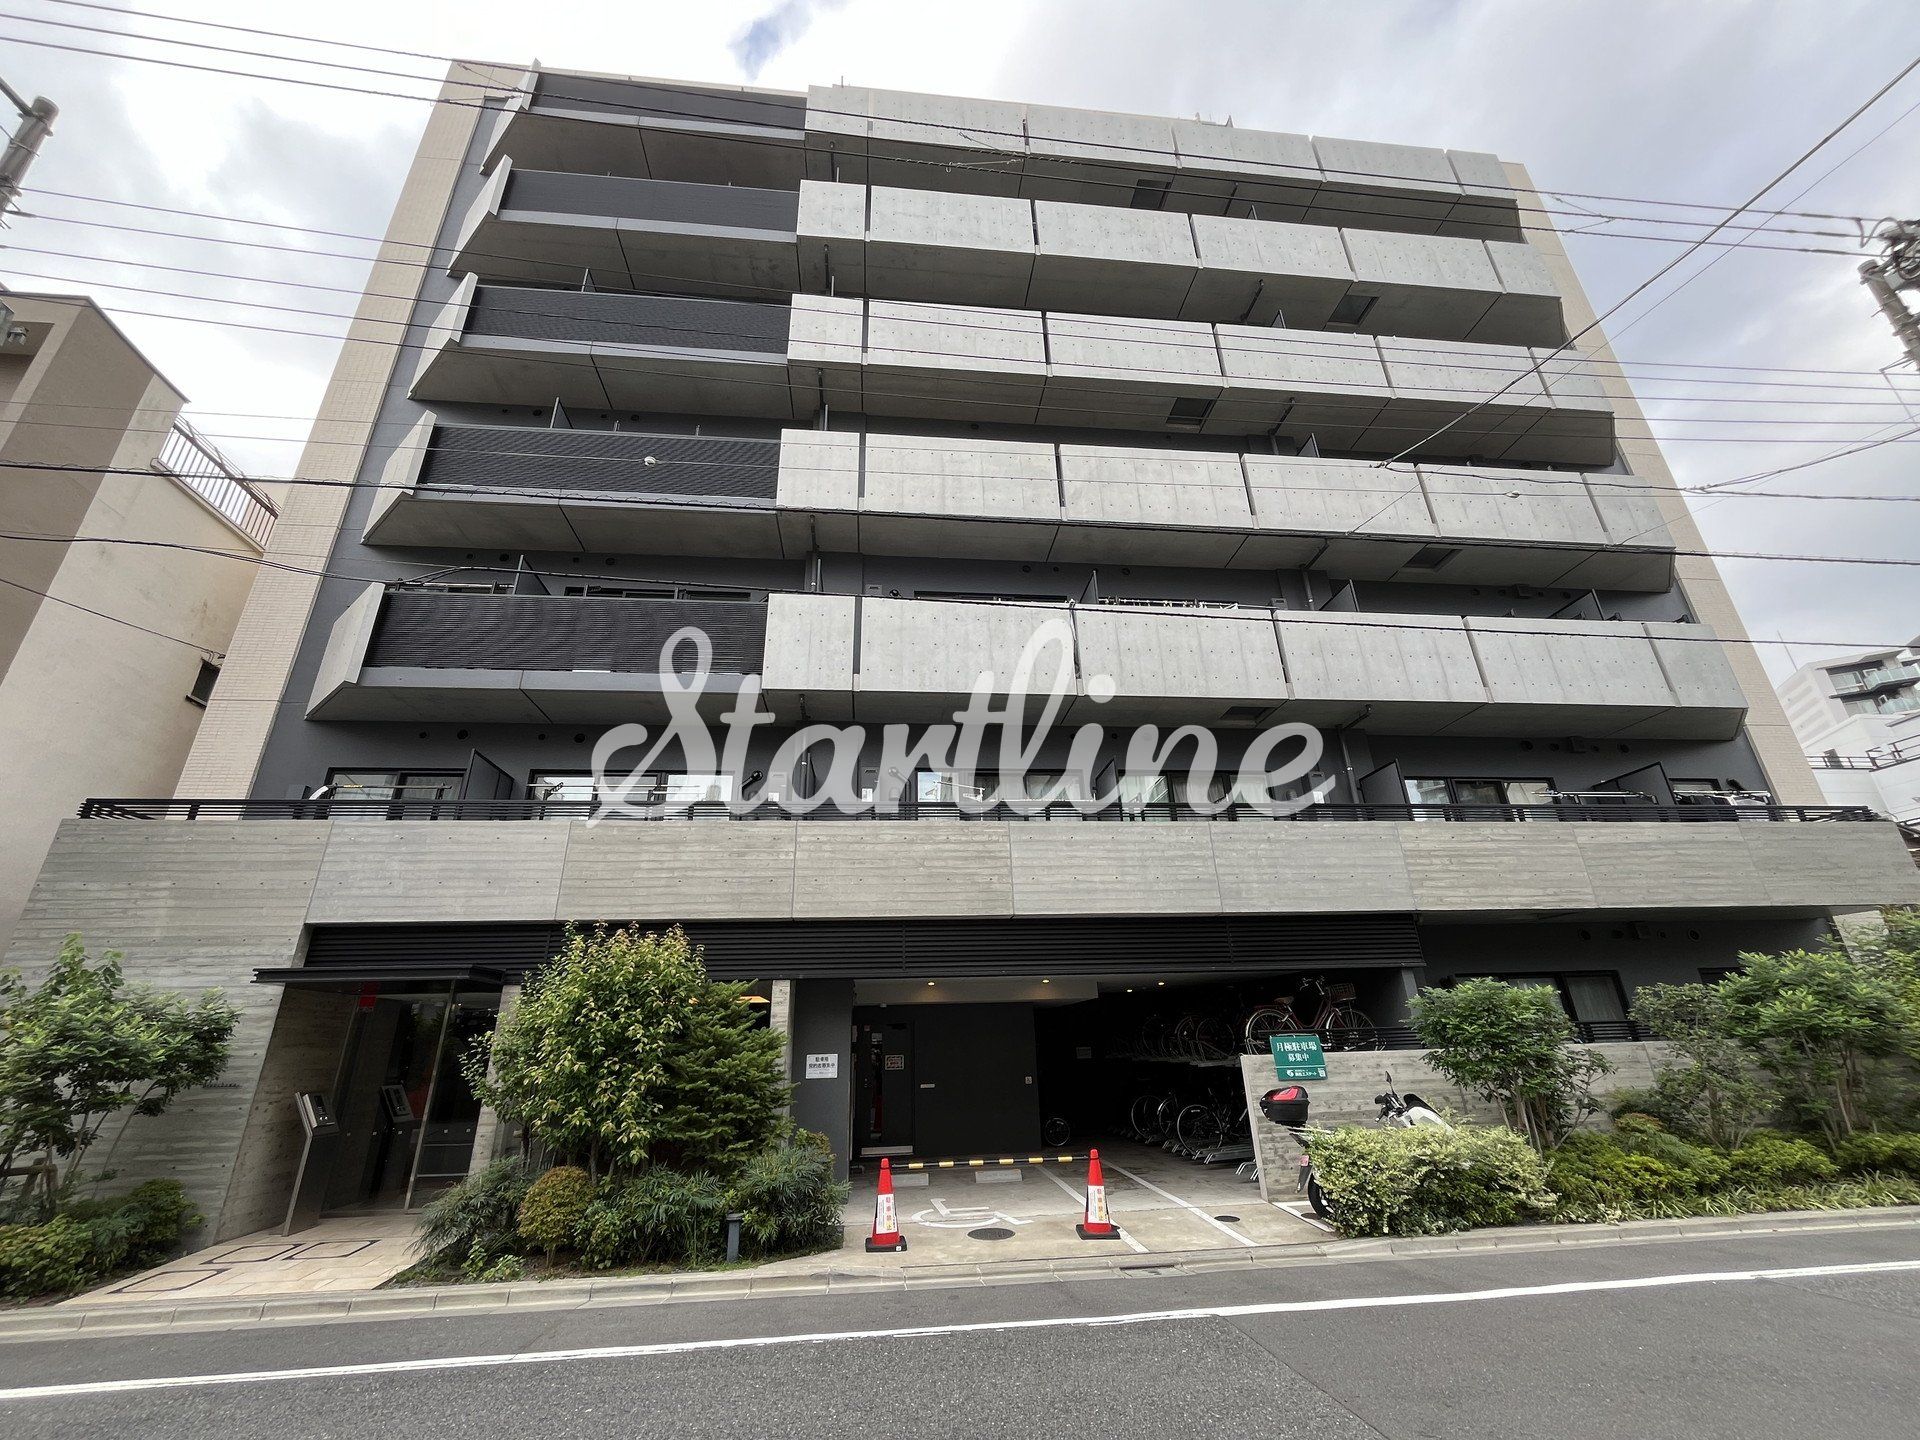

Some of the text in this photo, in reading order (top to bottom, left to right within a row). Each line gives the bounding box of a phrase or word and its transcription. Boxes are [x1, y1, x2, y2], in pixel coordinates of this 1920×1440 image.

[1276, 1041, 1317, 1051] 月極駐車場
[1288, 1053, 1309, 1062] 募集中
